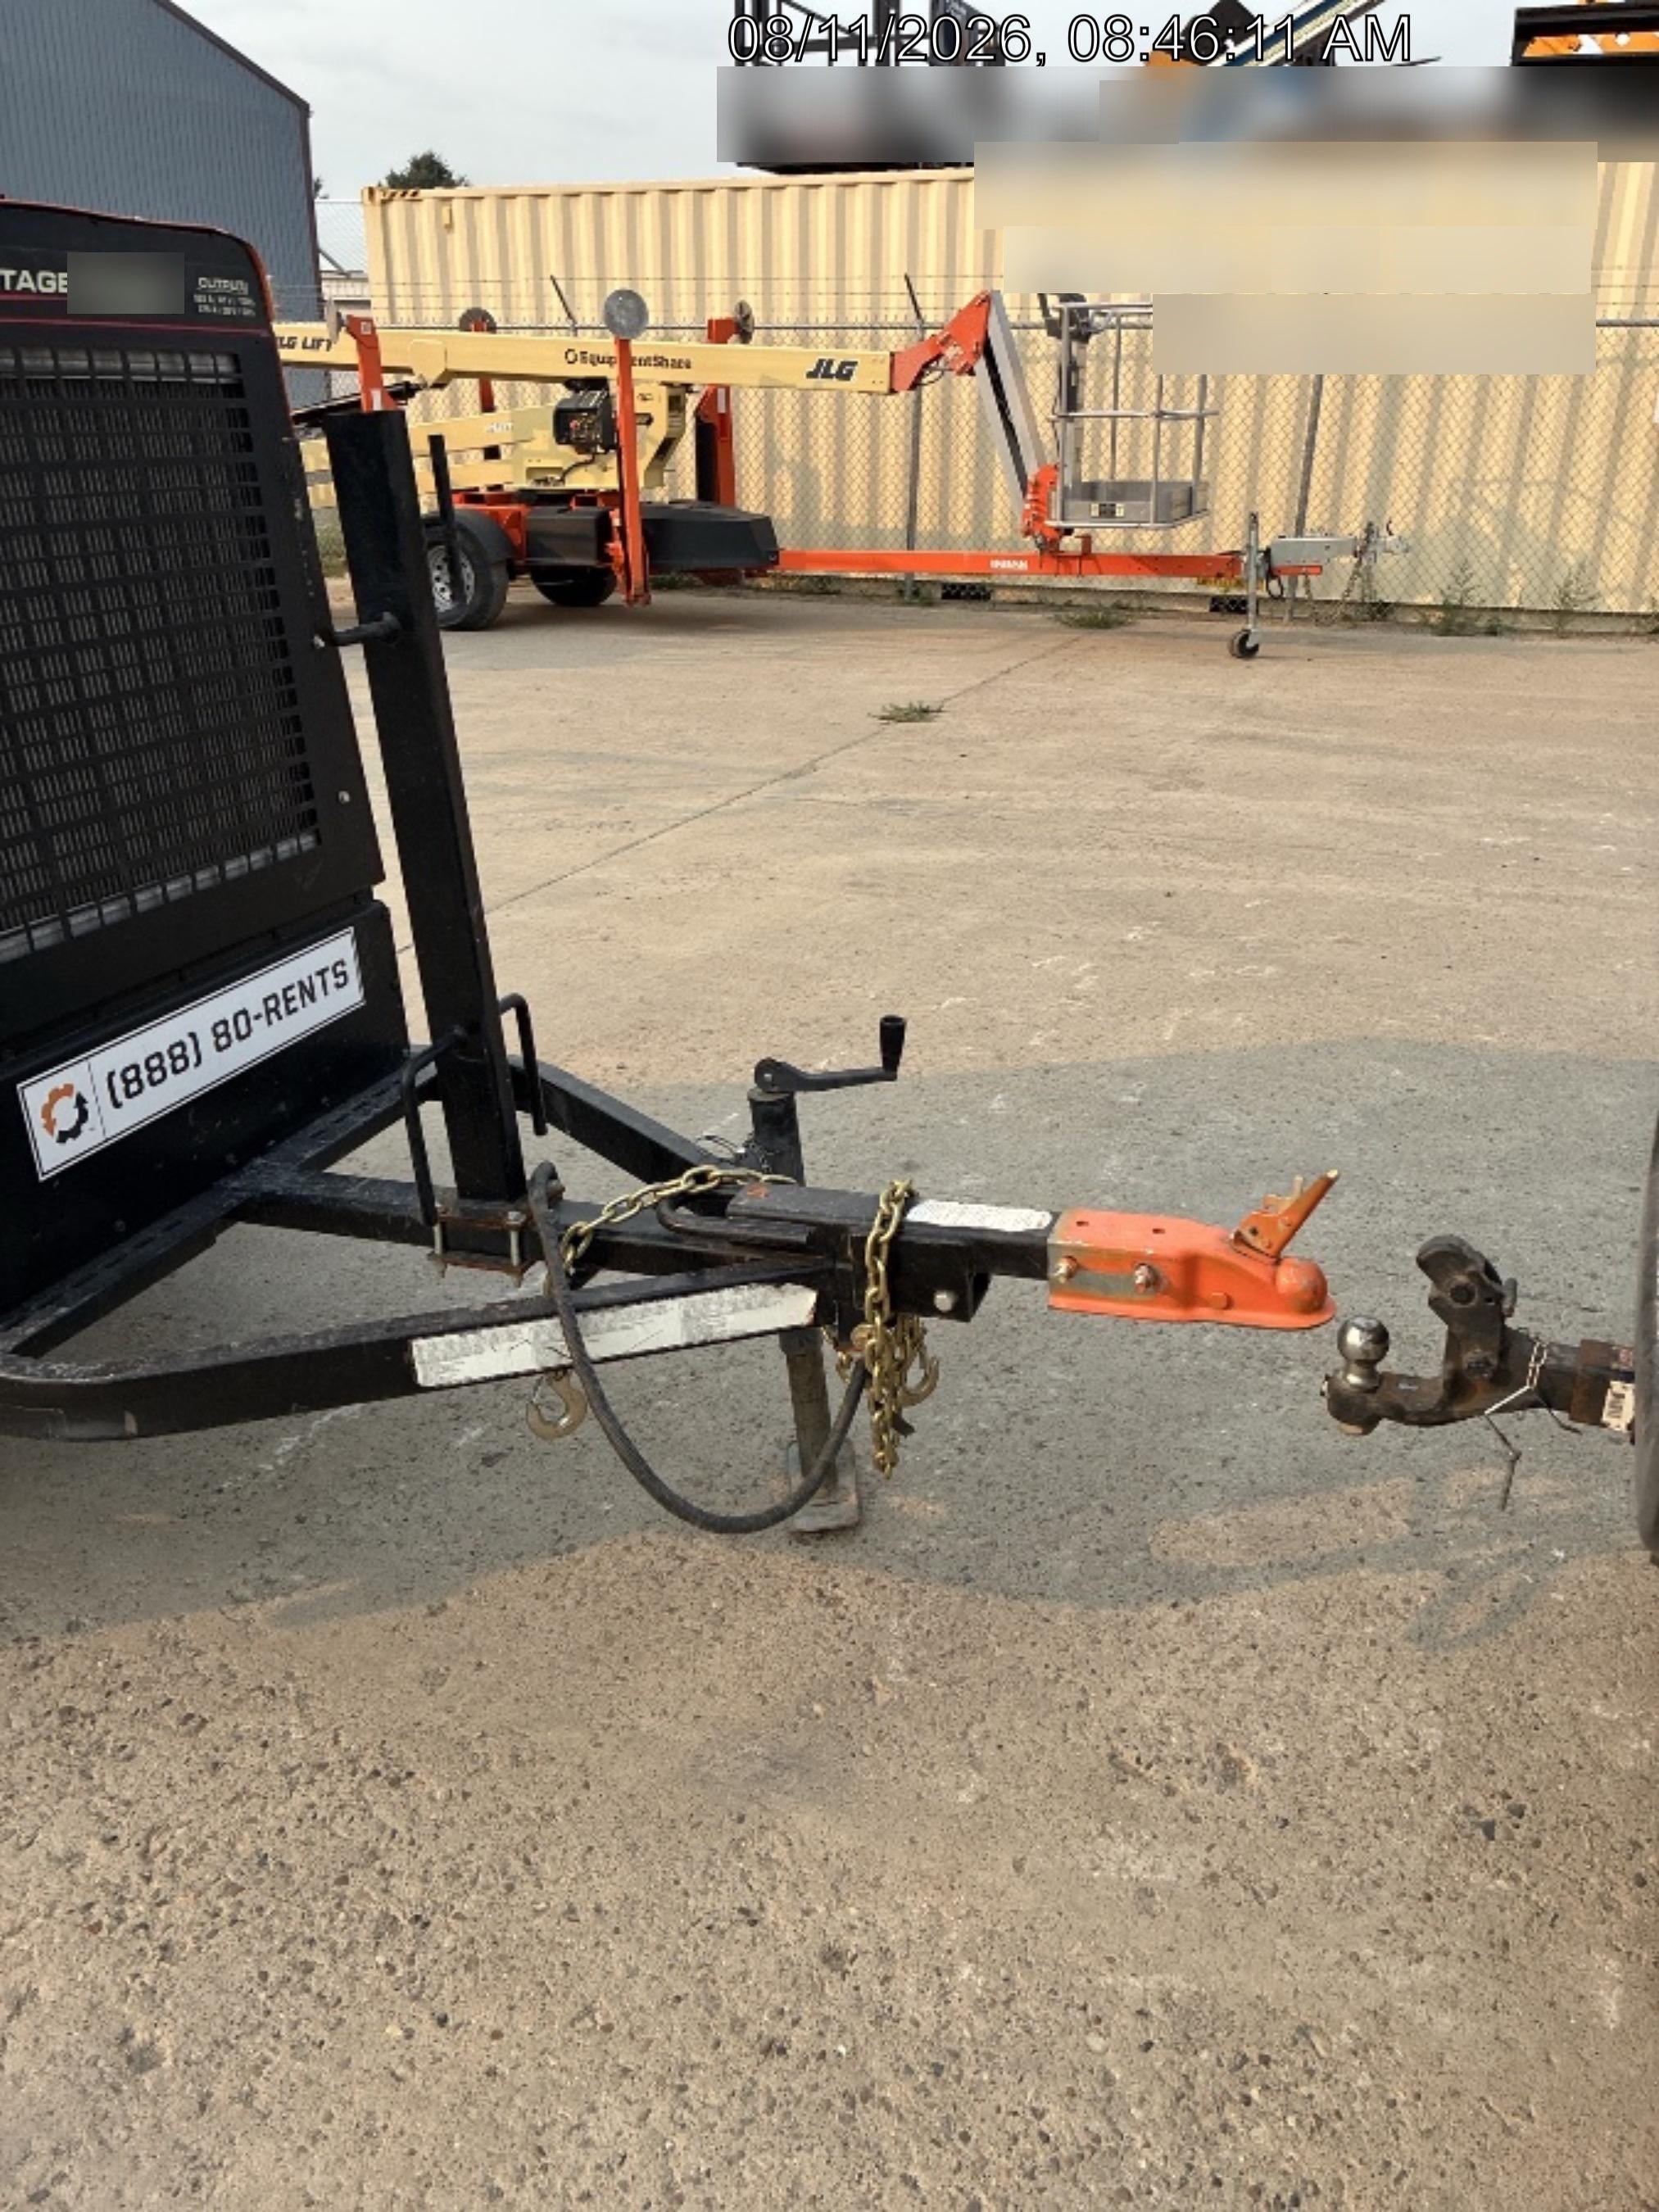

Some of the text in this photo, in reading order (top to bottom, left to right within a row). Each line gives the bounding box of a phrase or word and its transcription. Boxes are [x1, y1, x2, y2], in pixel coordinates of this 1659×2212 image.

[580, 351, 691, 369] EquipentShare
[806, 359, 858, 381] JLG
[107, 959, 349, 1108] (888) 80-RENTS
